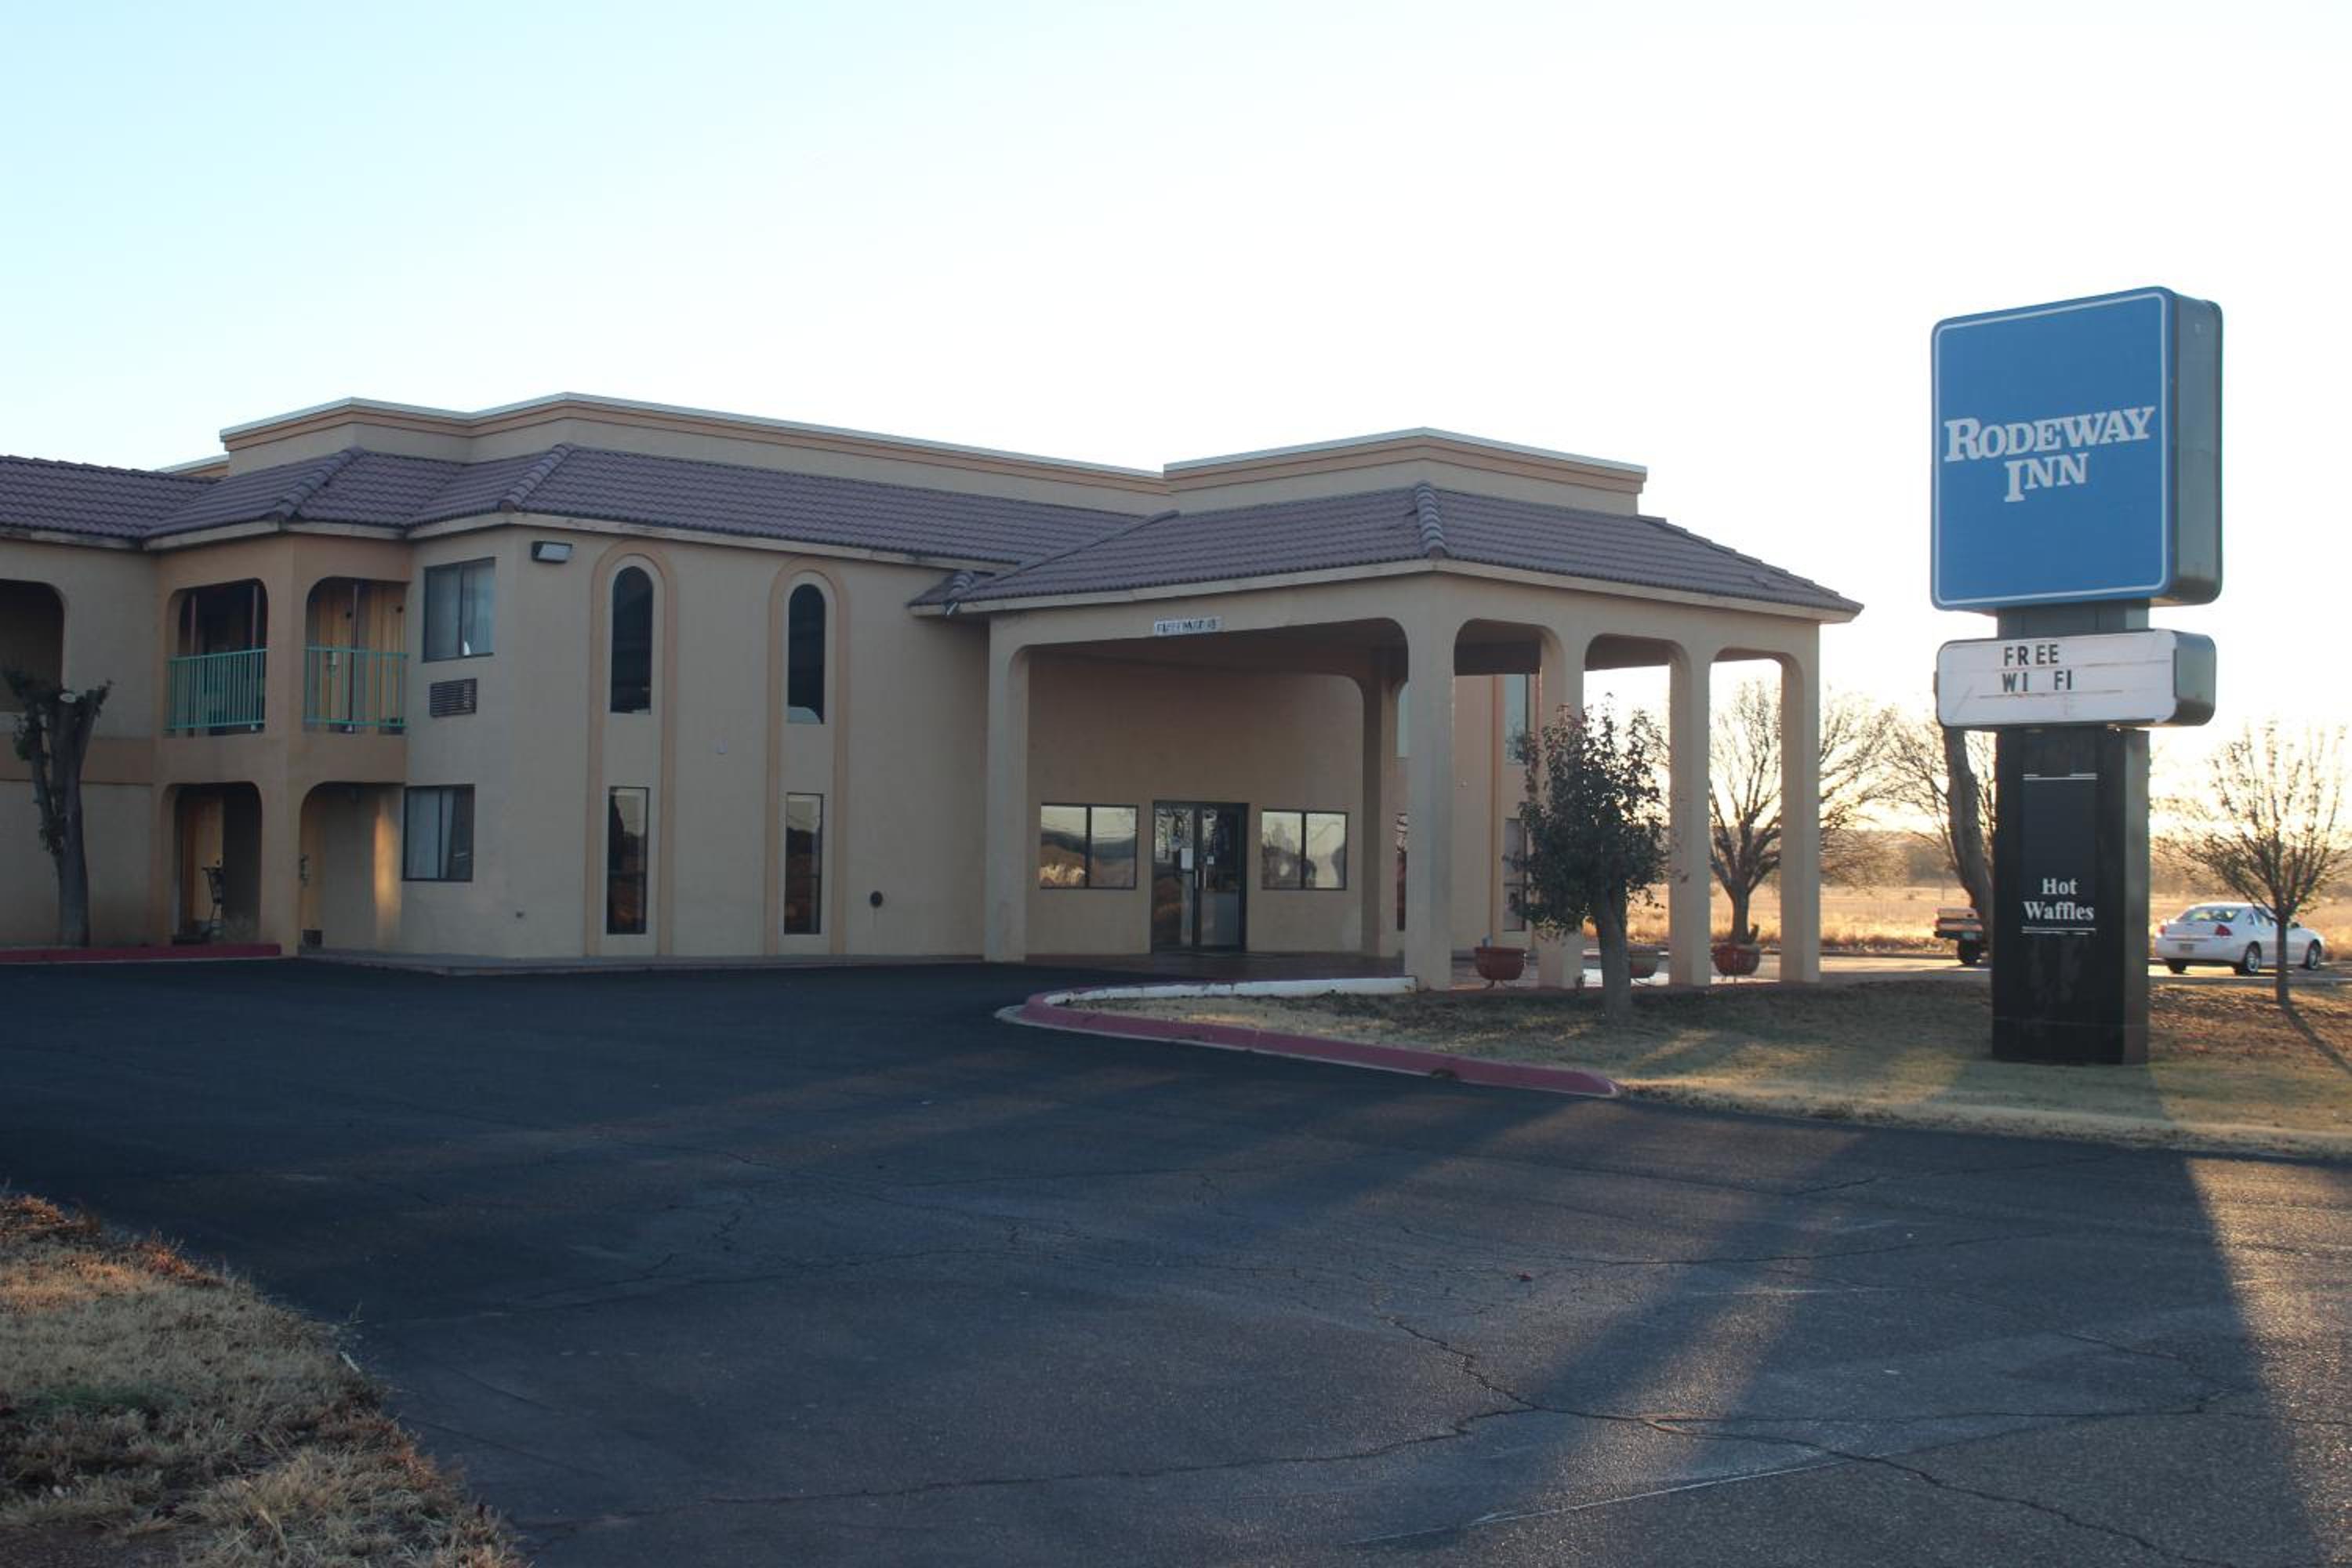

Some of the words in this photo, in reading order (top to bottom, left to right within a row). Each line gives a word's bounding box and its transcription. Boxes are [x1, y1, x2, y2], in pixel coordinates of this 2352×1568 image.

[1944, 406, 2155, 463] RODEWAY
[2004, 452, 2089, 503] INN
[2004, 644, 2059, 667] FREE
[2002, 672, 2028, 693] WI
[2054, 670, 2072, 691] FI
[2042, 877, 2078, 895] Hot
[2022, 901, 2095, 920] Waffles
